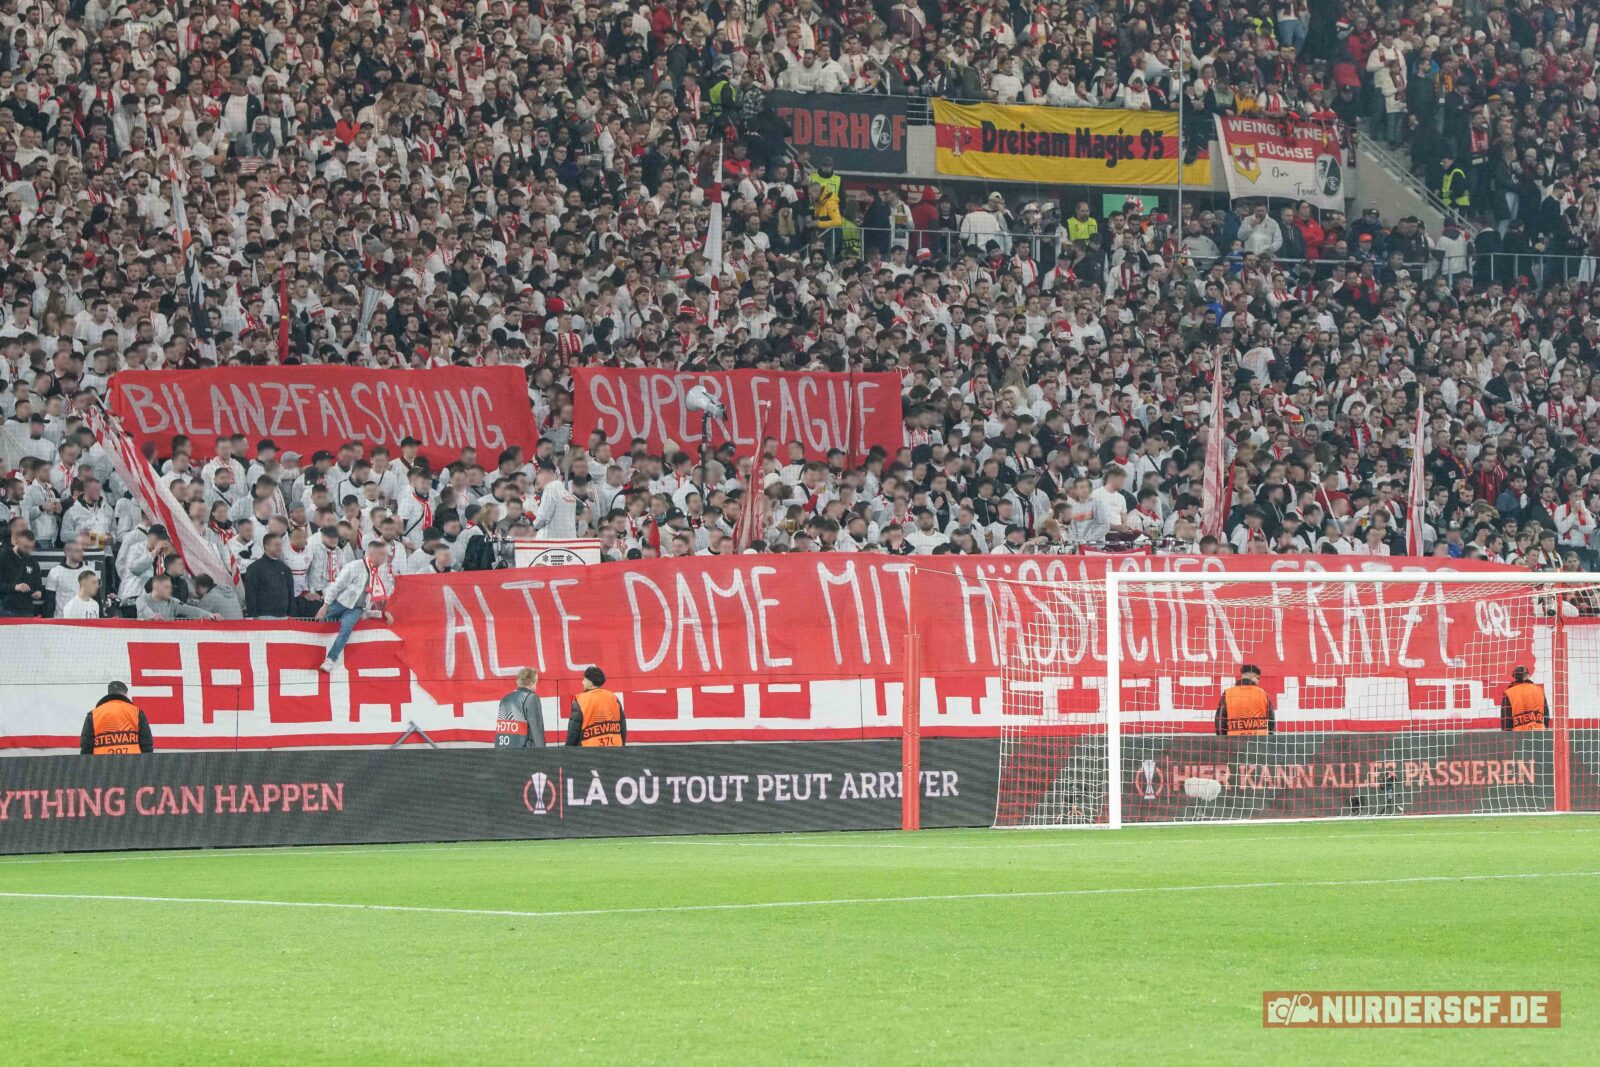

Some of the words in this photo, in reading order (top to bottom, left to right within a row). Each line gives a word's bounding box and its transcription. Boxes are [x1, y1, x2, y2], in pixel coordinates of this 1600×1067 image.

[981, 120, 1070, 158] Dreisam
[1075, 127, 1134, 168] Magic
[1140, 129, 1165, 160] 95
[1228, 119, 1333, 142] WEINGTNE
[1257, 140, 1315, 160] FÜCHSE
[120, 381, 508, 451] BILANZFÄLSCHUNG
[589, 373, 880, 456] SUPERLEAGUE
[443, 578, 598, 680] ALTE
[624, 566, 793, 673] DAME
[817, 560, 916, 665] MIT
[1271, 560, 1467, 668] FRATZE
[567, 770, 609, 806] LÀ
[615, 769, 660, 805] OÙ
[666, 774, 749, 804] TOUT
[757, 772, 833, 801] PEUT
[840, 770, 960, 799] ARRIER
[1239, 763, 1316, 790] KANN
[1321, 761, 1397, 788] ALLES
[1404, 759, 1536, 787] PASSIEREN
[0, 786, 127, 820] YTHING
[136, 785, 205, 816] CAN
[214, 782, 344, 814] HAPPEN
